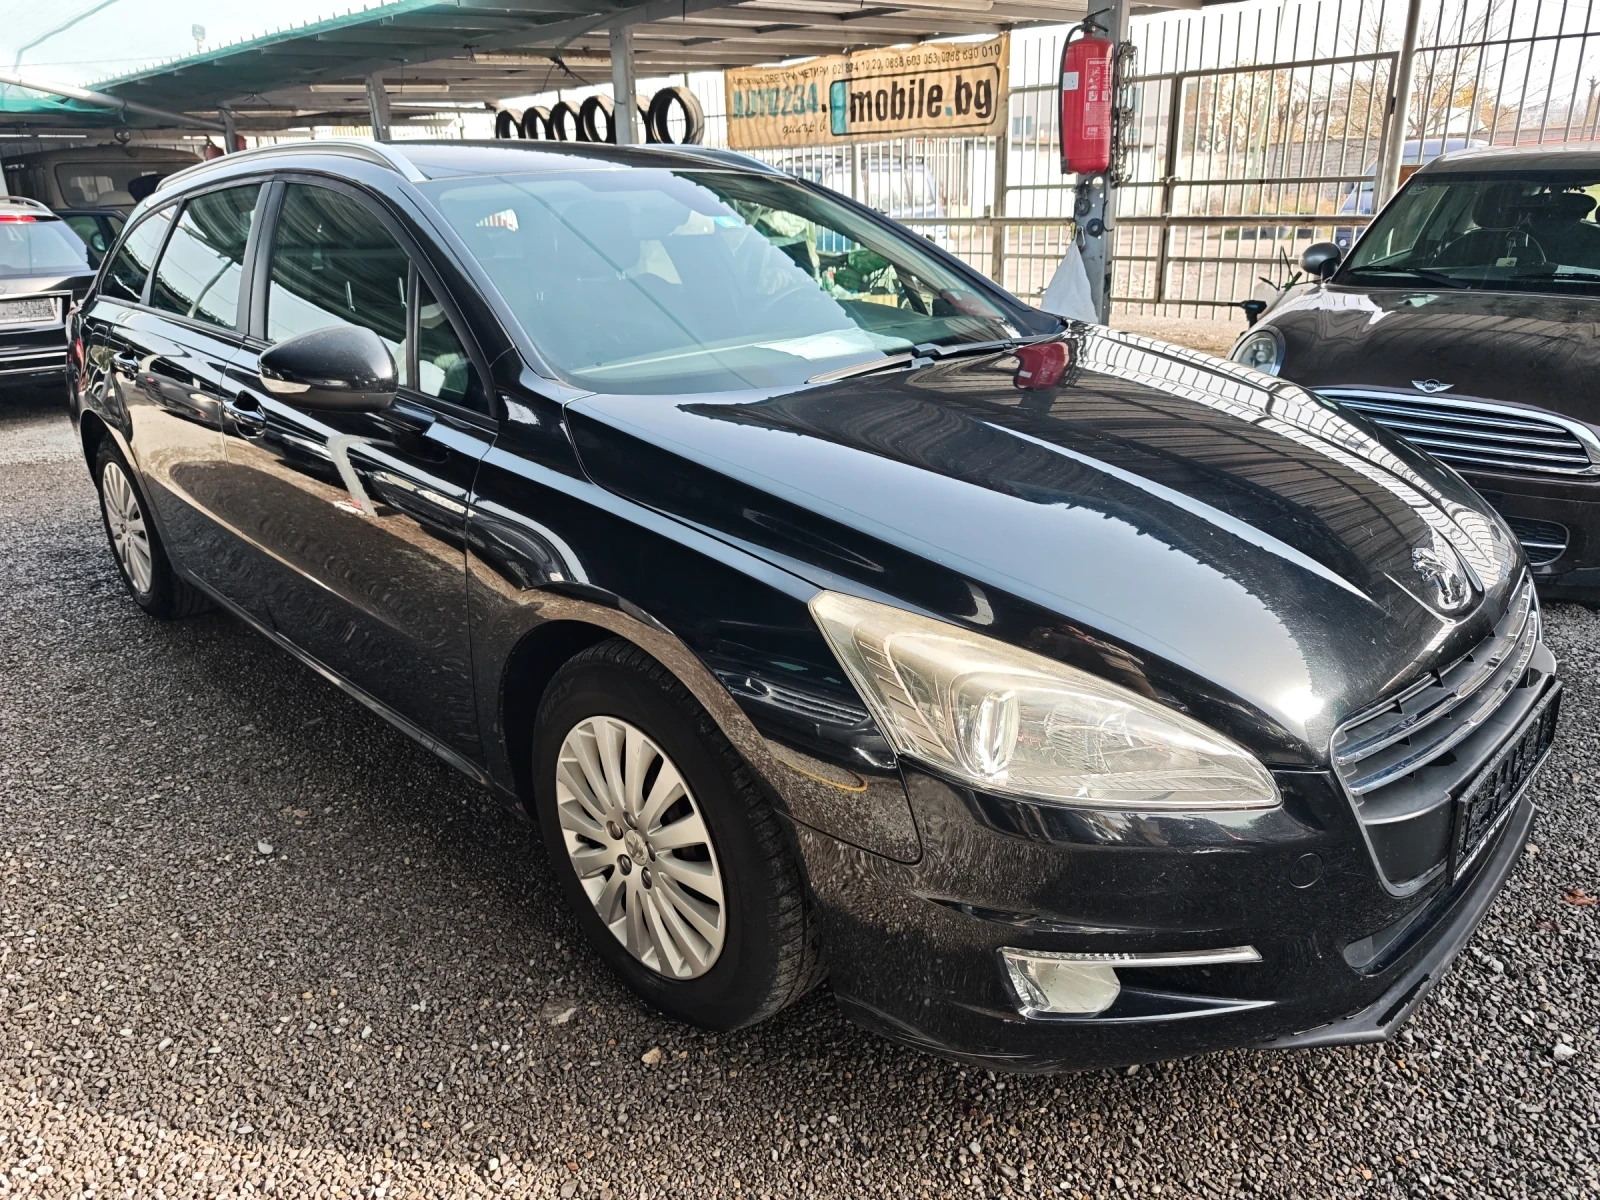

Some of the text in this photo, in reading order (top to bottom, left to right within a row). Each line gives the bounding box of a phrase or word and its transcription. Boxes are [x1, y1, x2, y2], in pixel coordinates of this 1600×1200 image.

[765, 74, 780, 84] ДВЕ
[782, 71, 798, 81] ТРИ
[798, 65, 829, 80] ЧЕТИРИ
[906, 54, 921, 66] 603
[981, 43, 1000, 58] 010
[850, 74, 992, 123] mobile.bg
[541, 677, 575, 727] HIFLY
